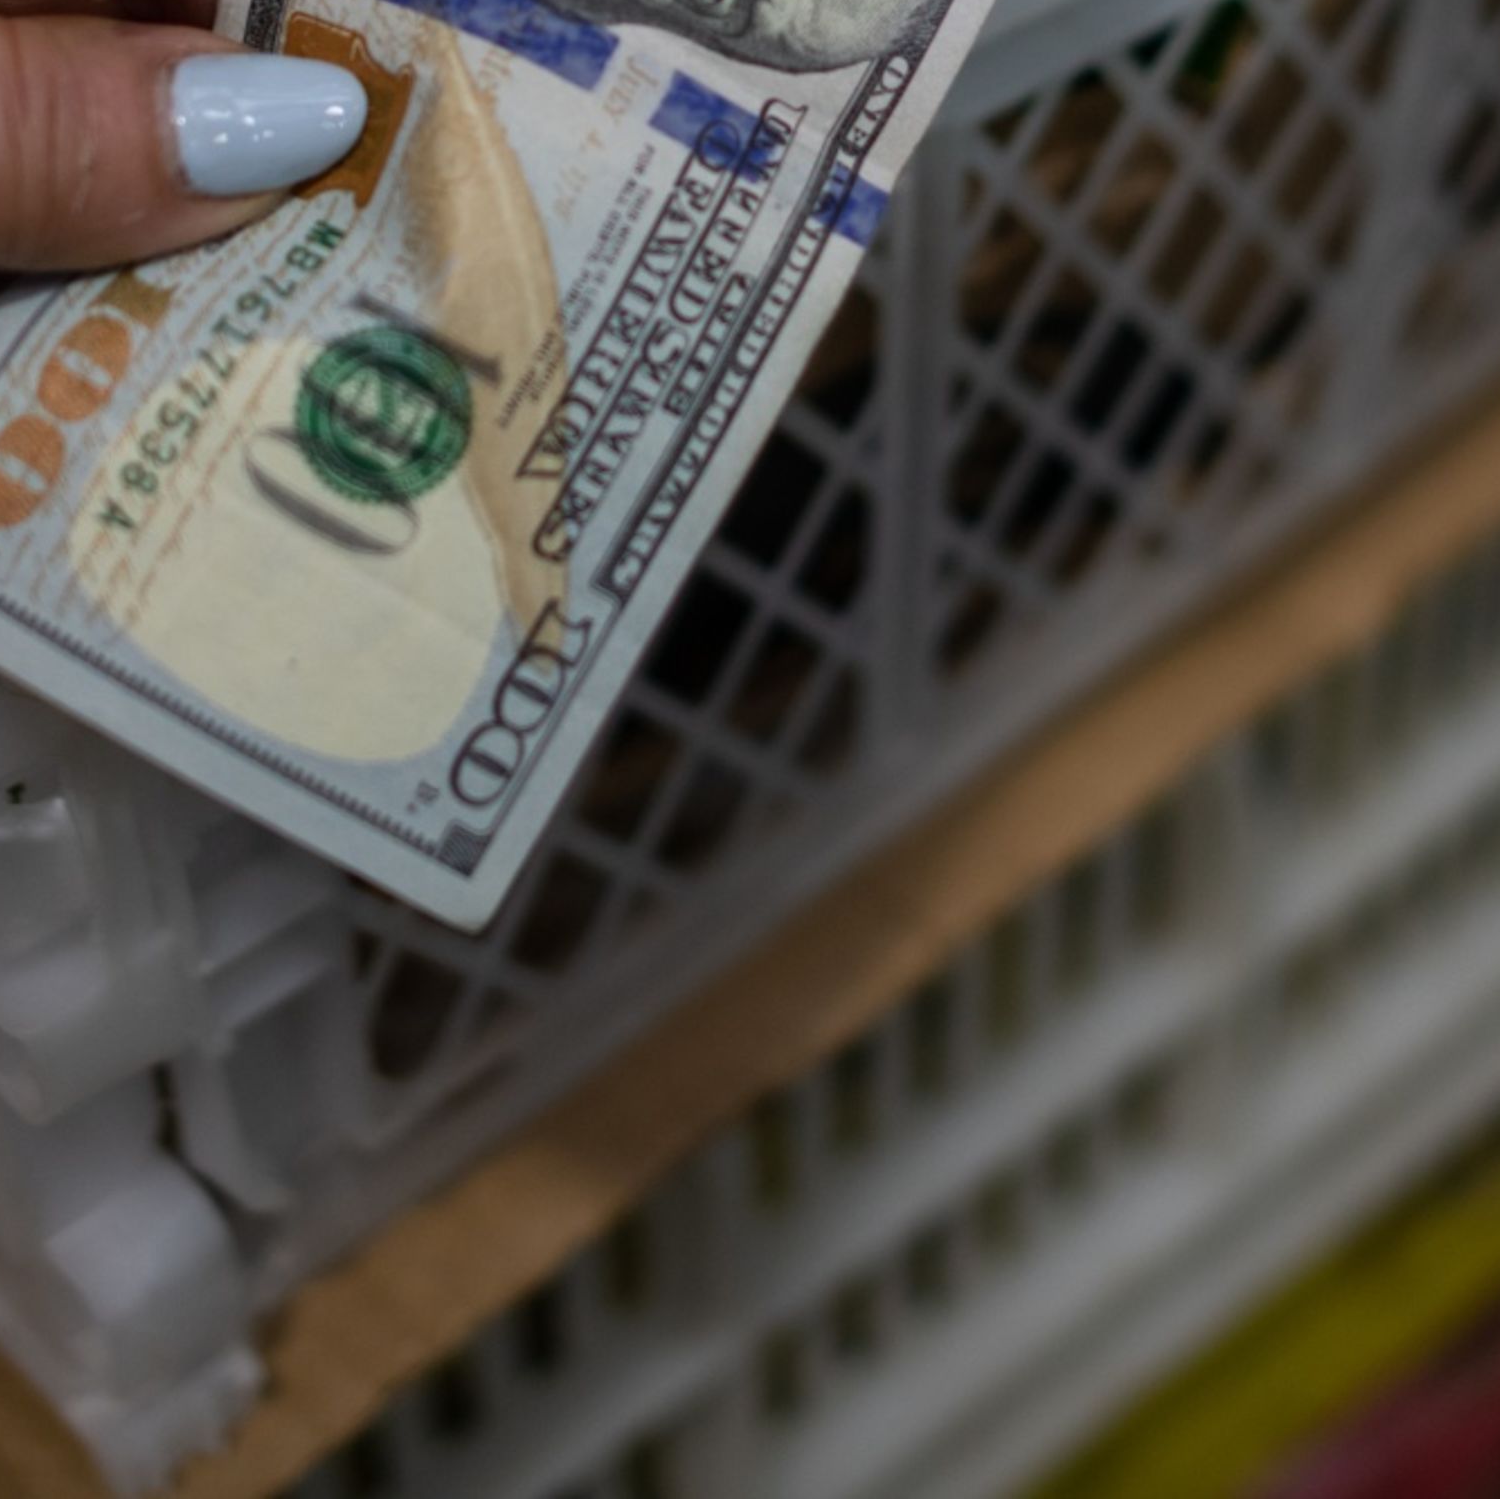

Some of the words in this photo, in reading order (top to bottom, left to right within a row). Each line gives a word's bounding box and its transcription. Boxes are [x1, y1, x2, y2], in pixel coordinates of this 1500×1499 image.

[661, 96, 807, 328] UNITED
[845, 52, 911, 148] ONE
[515, 191, 701, 477] AMERICA
[526, 317, 692, 569] STATES
[95, 495, 143, 537] A
[608, 366, 748, 591] DOLLARS
[449, 595, 594, 806] 100
